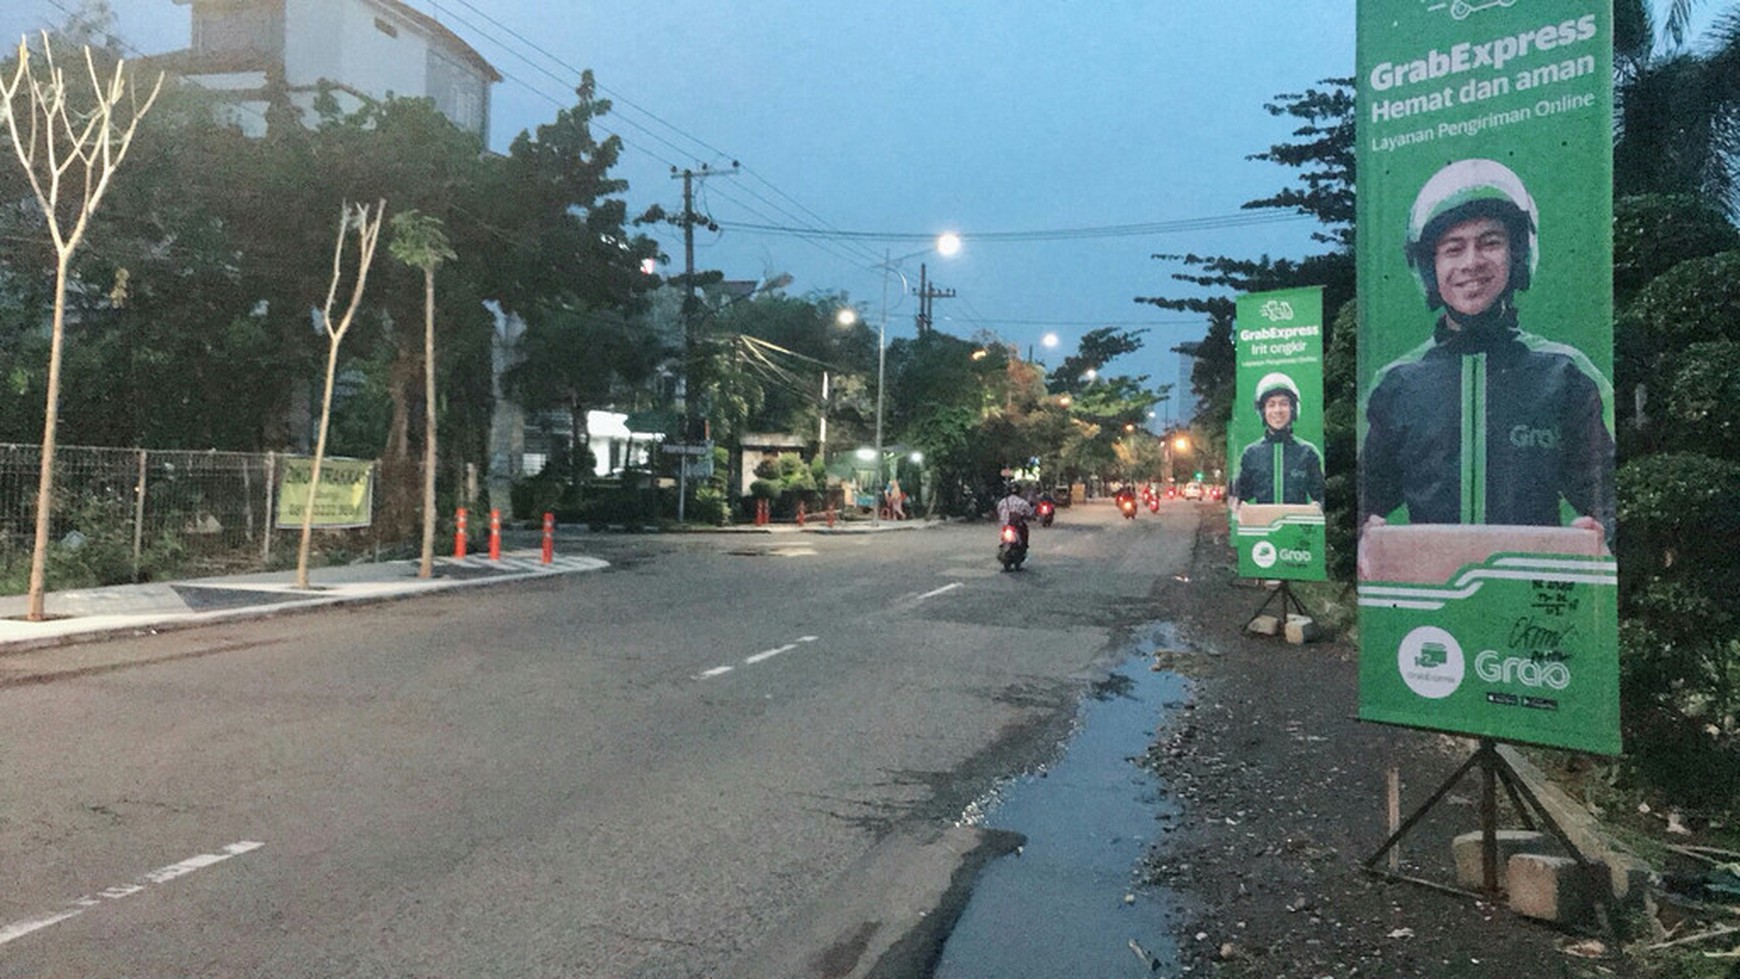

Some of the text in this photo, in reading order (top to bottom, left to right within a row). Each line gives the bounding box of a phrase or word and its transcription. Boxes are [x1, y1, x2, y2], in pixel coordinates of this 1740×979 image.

[1370, 14, 1597, 91] GrabExpress
[1372, 55, 1595, 123] Hemat dan aman
[1372, 92, 1595, 151] Layanan Pengiriman Online
[1240, 325, 1319, 341] GrabExpress
